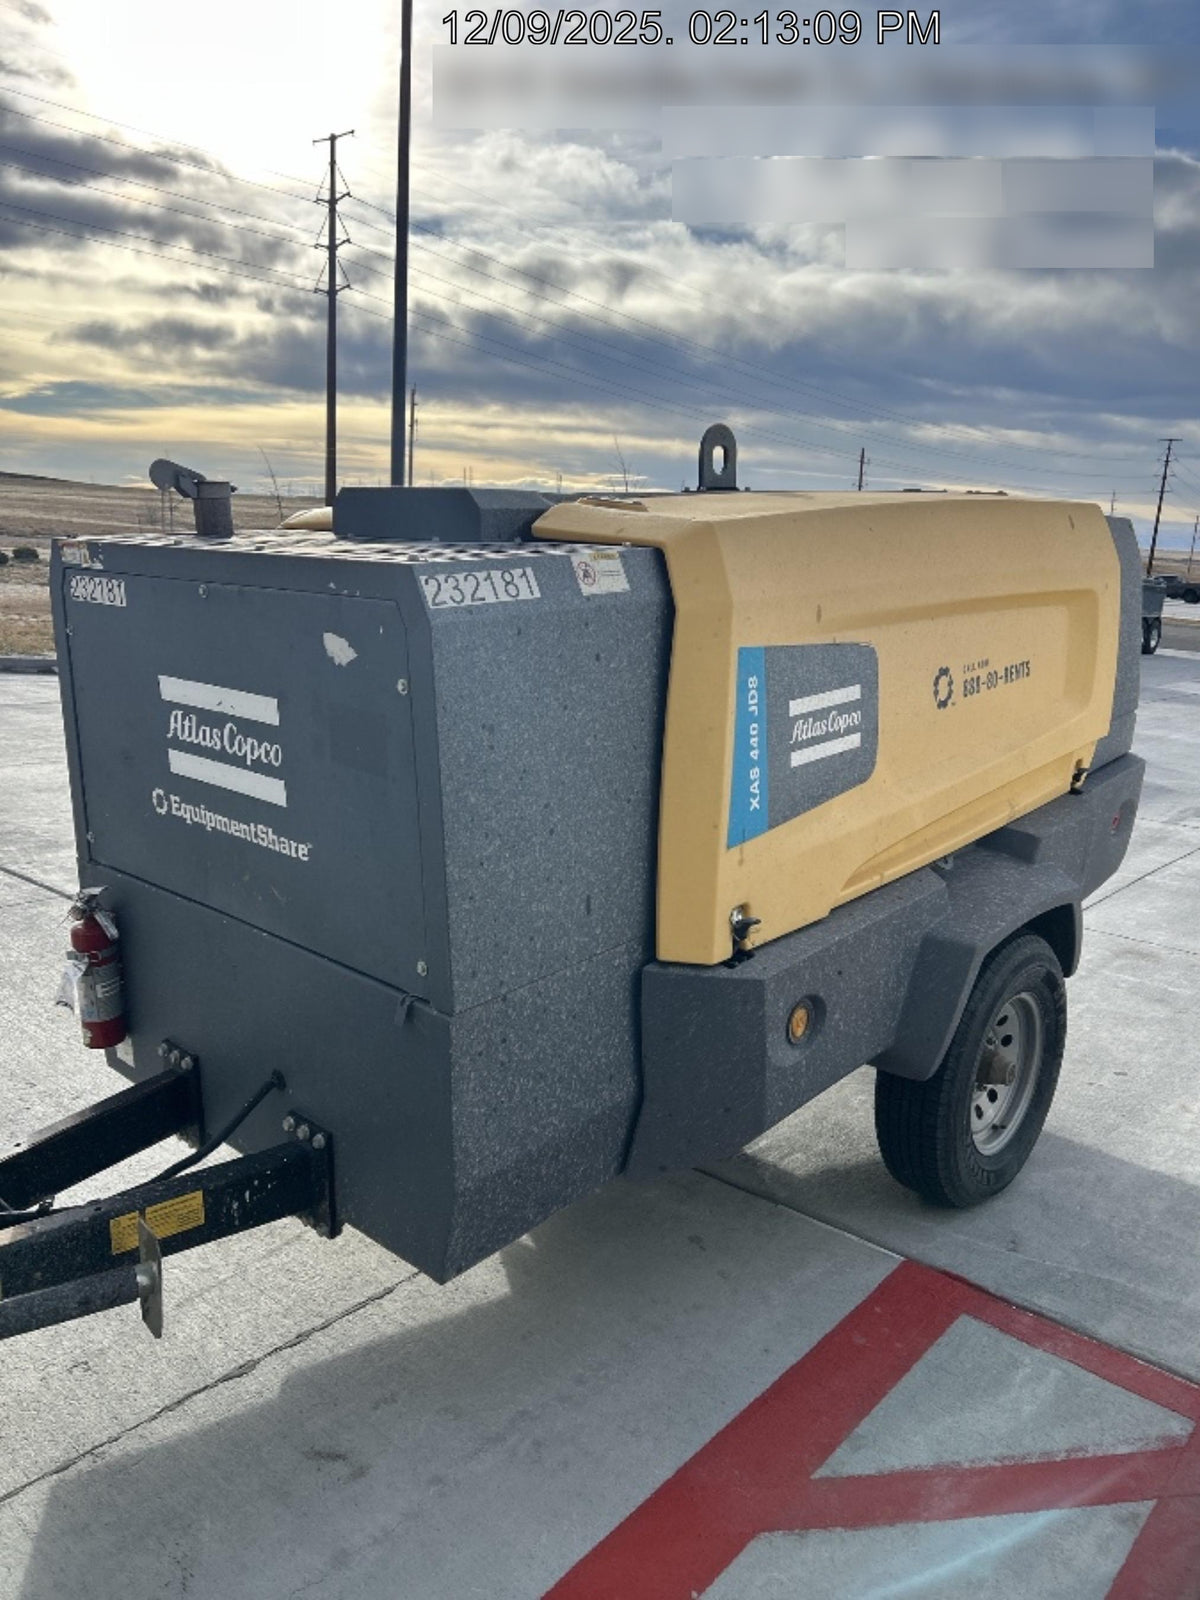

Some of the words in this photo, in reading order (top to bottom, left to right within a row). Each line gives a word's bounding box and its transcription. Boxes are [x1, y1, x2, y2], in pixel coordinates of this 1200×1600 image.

[424, 568, 536, 607] 232181
[748, 675, 759, 716] JD8
[749, 724, 760, 760] 440
[170, 794, 310, 861] EquipmentShare
